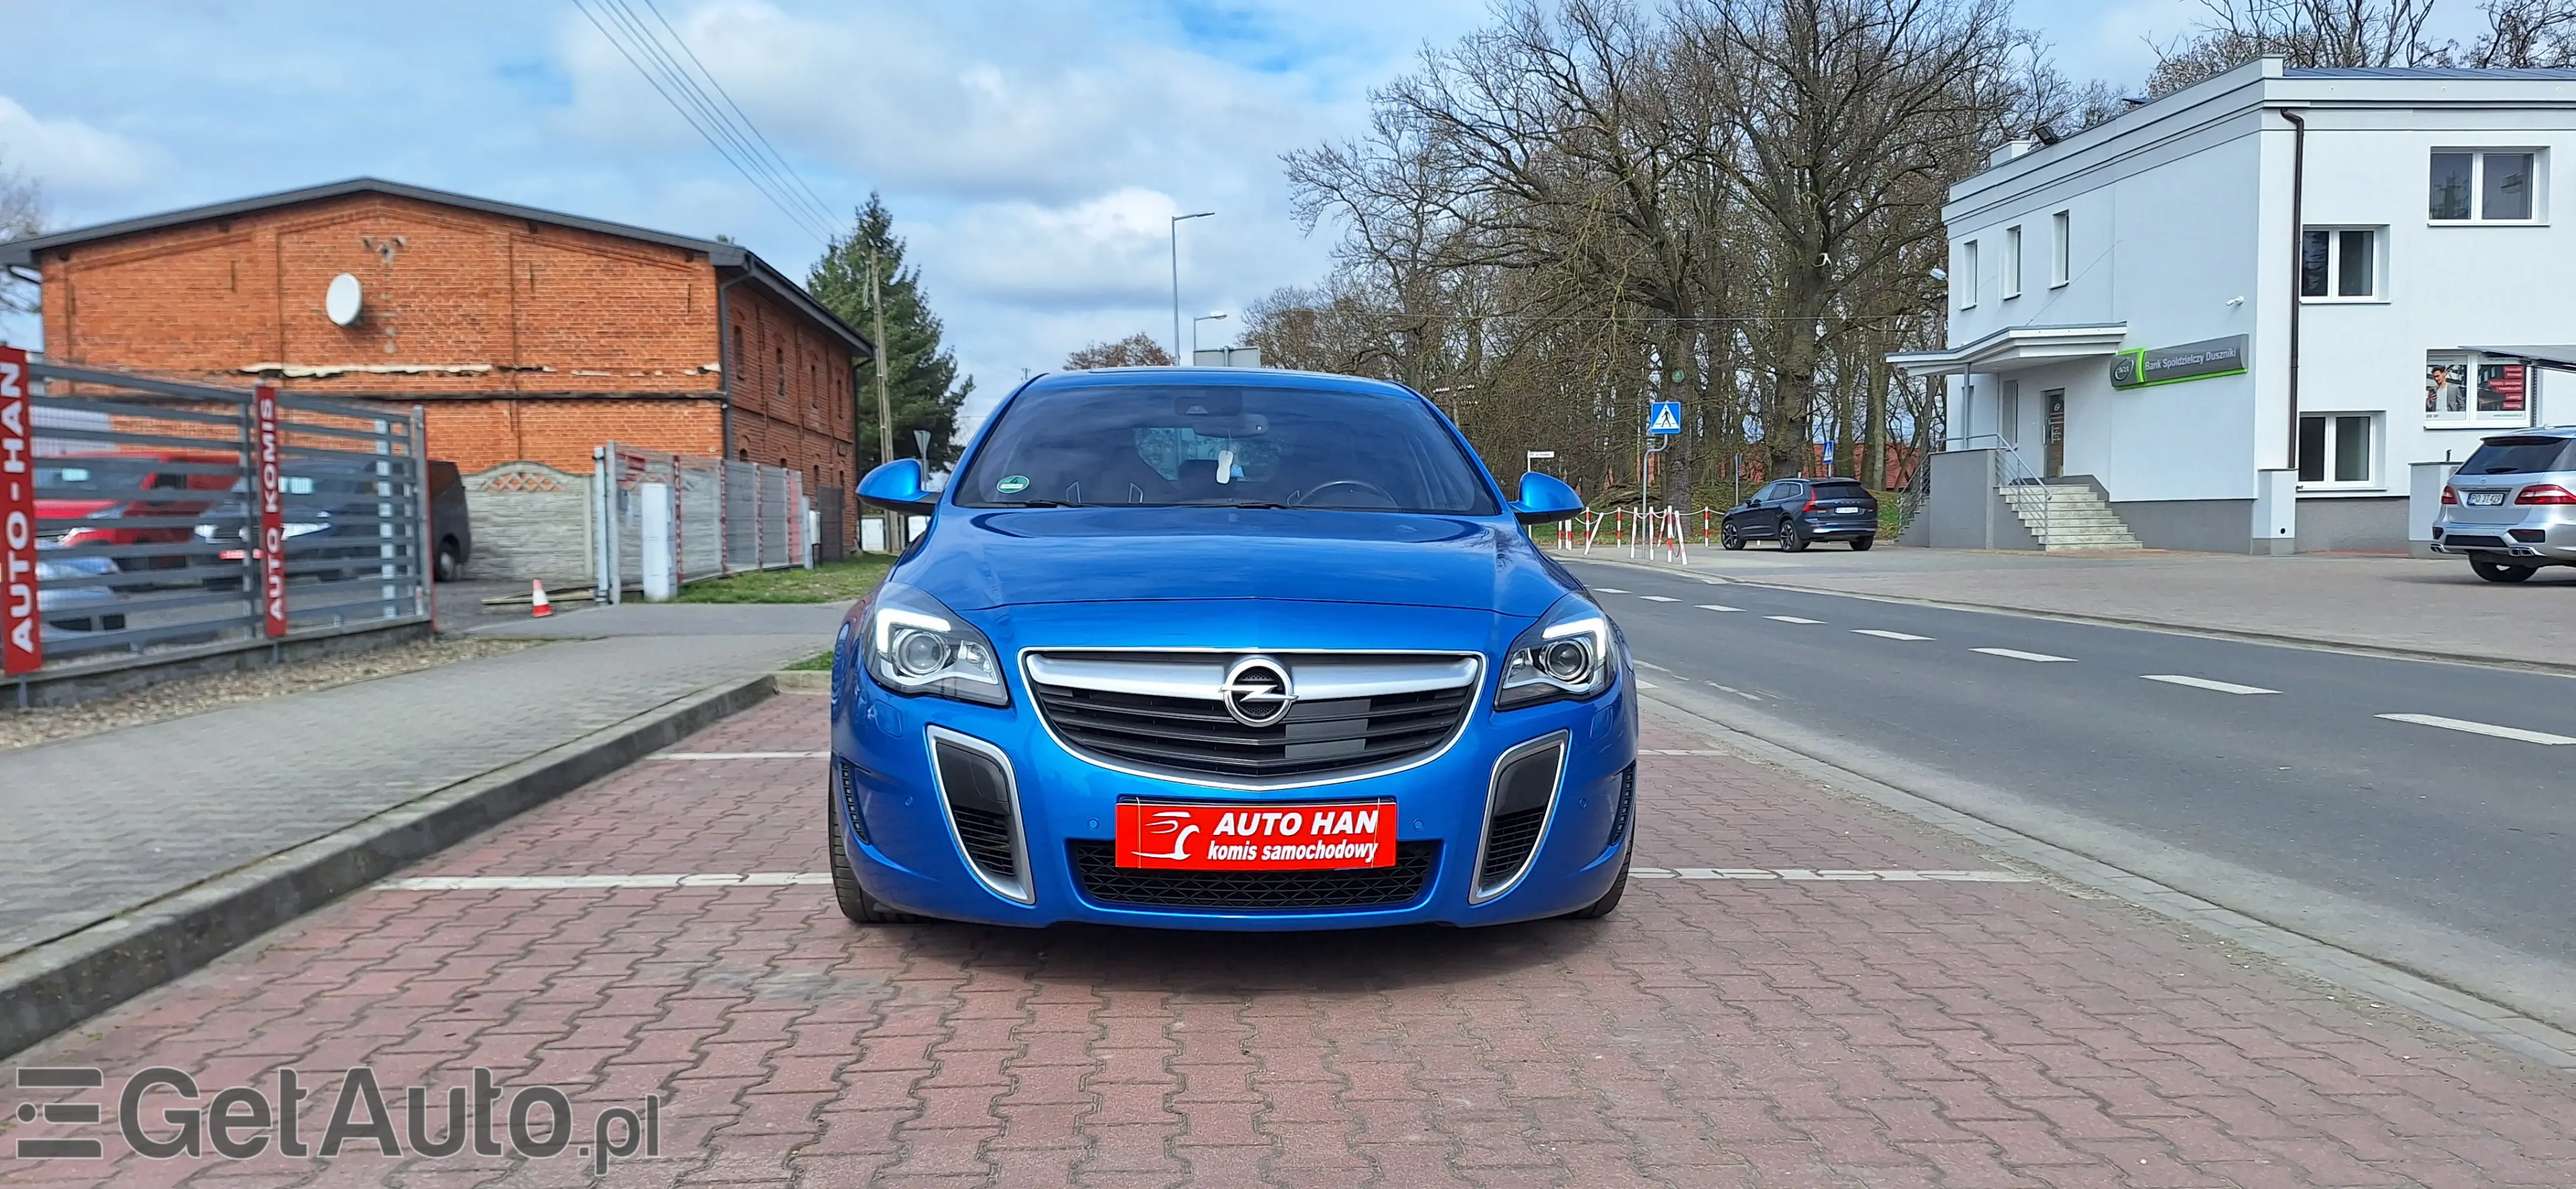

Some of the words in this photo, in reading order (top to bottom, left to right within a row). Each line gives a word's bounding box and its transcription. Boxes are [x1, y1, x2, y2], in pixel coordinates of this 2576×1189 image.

[2145, 360, 2161, 371] Bank
[2206, 349, 2237, 361] Duszniki
[0, 362, 25, 473] HAN
[260, 398, 278, 513] KOMIS
[7, 510, 34, 654] AUTO
[266, 527, 283, 621] AUTO
[1208, 840, 1257, 860] komis
[1261, 839, 1379, 862] samochodowy
[1213, 812, 1301, 836] AUTO
[1310, 810, 1379, 835] HAN
